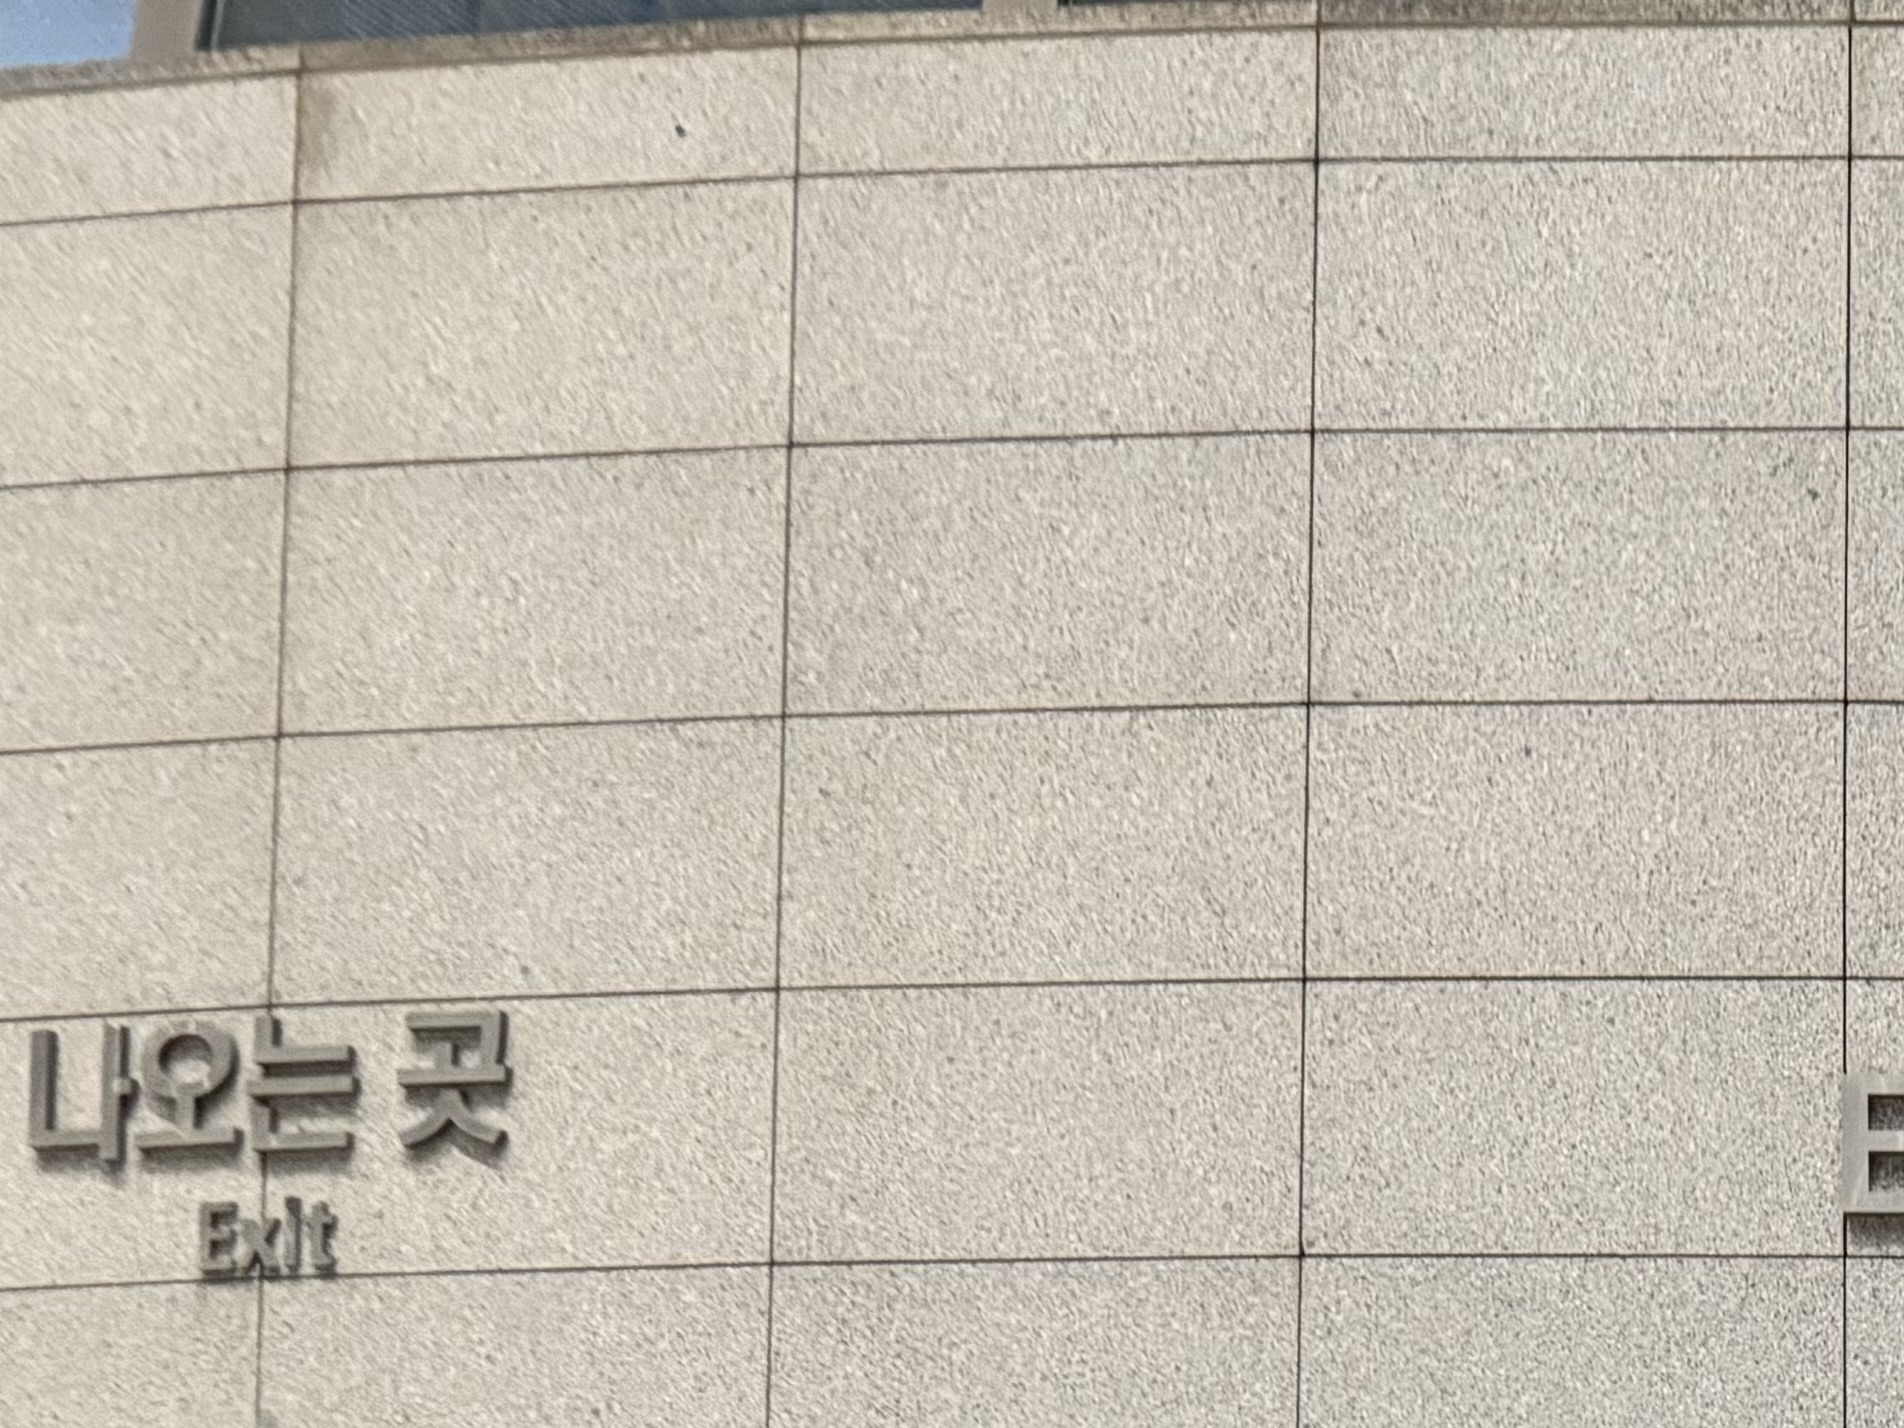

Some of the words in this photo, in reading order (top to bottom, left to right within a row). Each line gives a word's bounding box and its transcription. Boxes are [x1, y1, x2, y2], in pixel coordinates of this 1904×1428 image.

[30, 1014, 359, 1166] 나오는
[399, 1010, 512, 1152] 곳
[200, 1196, 337, 1278] Exit
